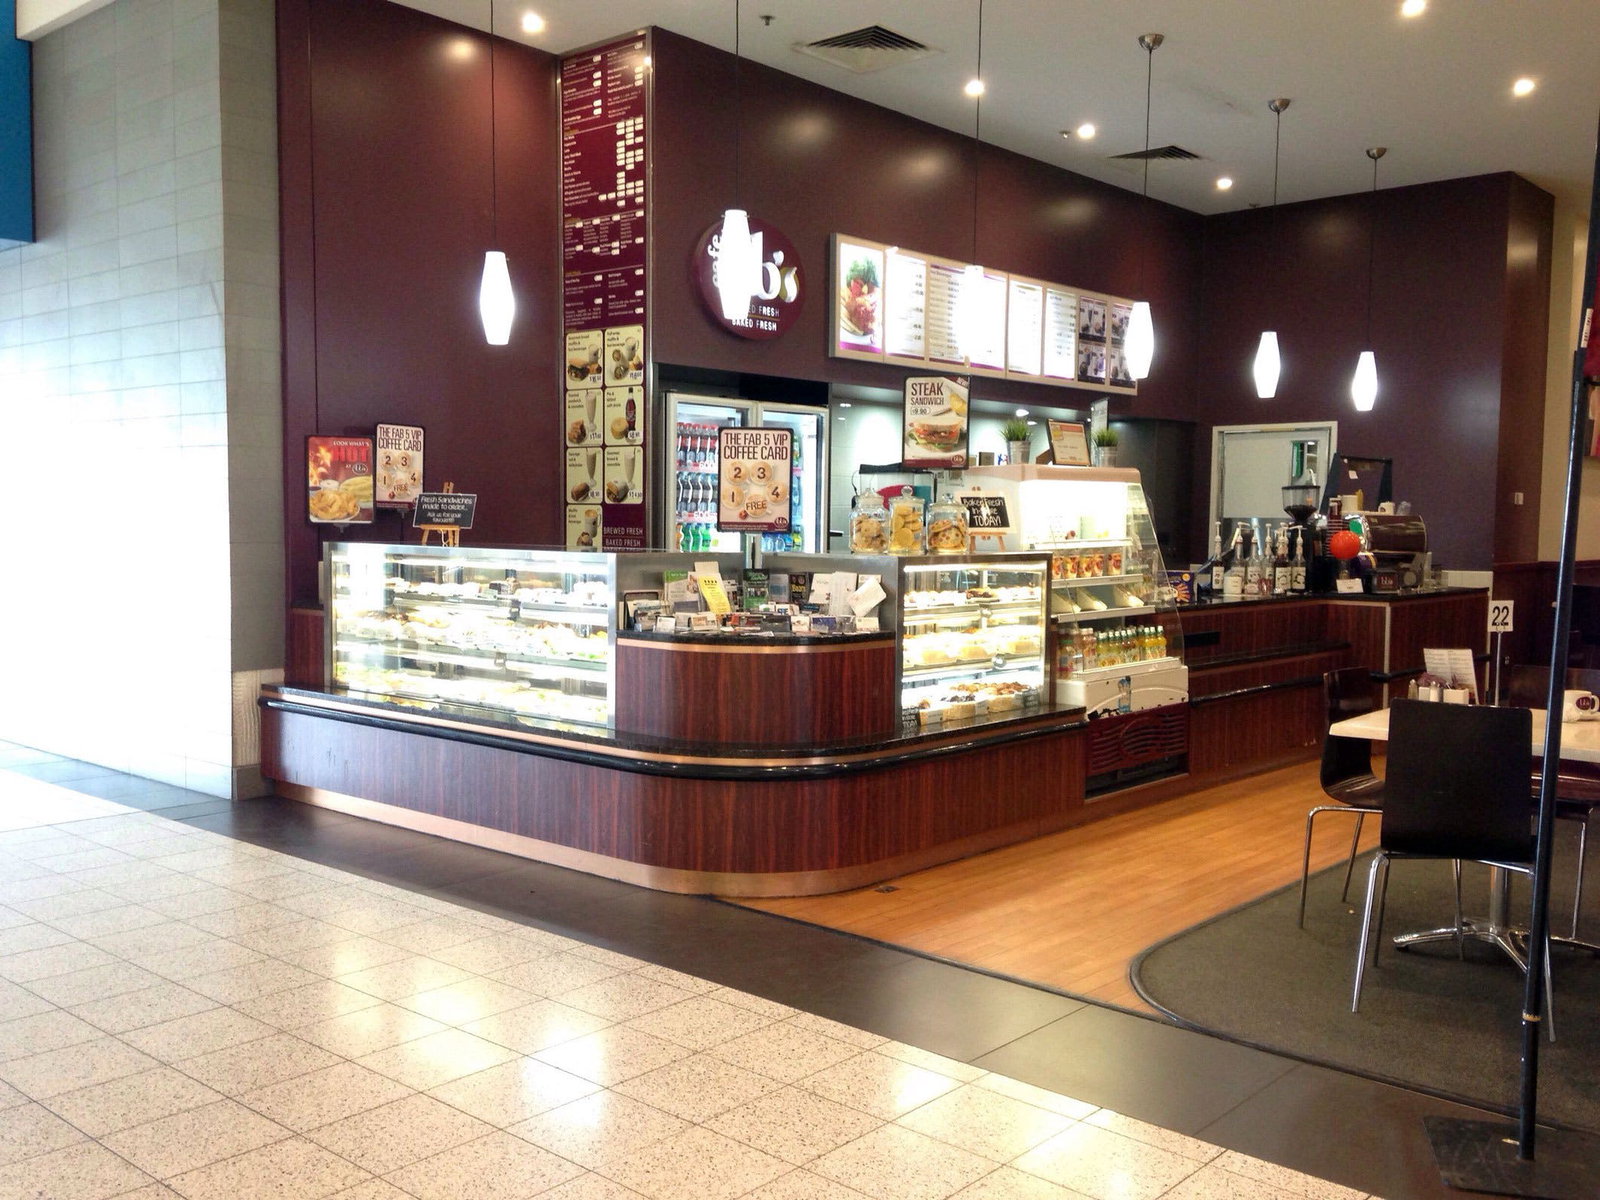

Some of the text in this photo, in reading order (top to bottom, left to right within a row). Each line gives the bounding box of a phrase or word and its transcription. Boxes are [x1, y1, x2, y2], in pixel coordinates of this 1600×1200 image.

[755, 319, 777, 331] FRESH
[911, 382, 944, 396] STEAK
[910, 397, 945, 406] SANDWICH
[378, 426, 422, 440] THE FAB 5 VIP
[724, 432, 788, 446] THE FAB 5 VIP
[378, 438, 422, 452] COFFEE CARD
[331, 446, 369, 462] HOT
[723, 445, 788, 460] COFFEE CARD
[385, 455, 408, 467] 2 3
[411, 472, 416, 482] 4
[733, 467, 766, 479] 2 3
[731, 486, 780, 503] 1 4
[745, 501, 768, 511] FREE
[972, 515, 1002, 527] TODAY!
[603, 526, 644, 536] BREWED FRESH
[605, 538, 641, 547] BAKED FRESH
[1491, 605, 1510, 627] 22
